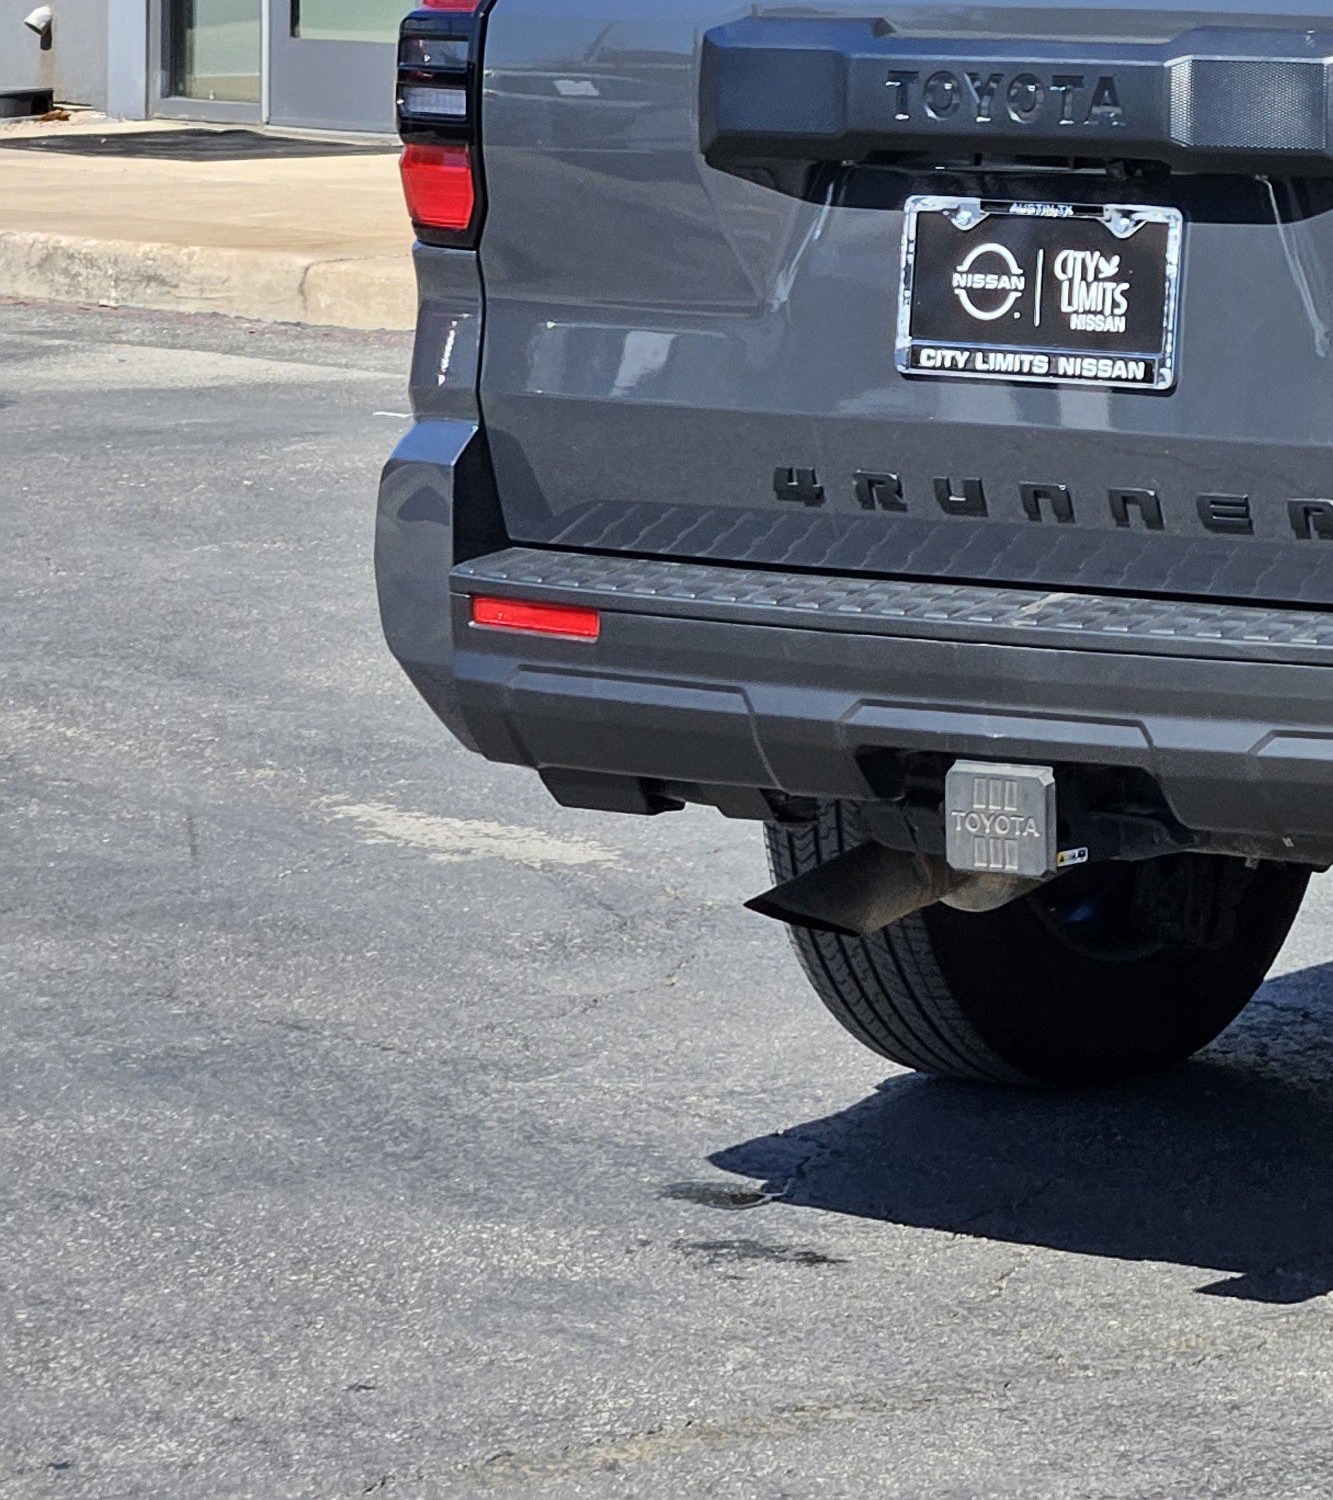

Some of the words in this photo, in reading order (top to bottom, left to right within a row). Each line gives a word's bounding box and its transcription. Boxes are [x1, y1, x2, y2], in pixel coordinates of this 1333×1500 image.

[884, 69, 1127, 127] TOYOTA
[952, 272, 1025, 291] NISSAN
[1054, 249, 1101, 282] CITY
[1060, 280, 1130, 316] LIMITS
[1070, 313, 1126, 334] NISSAN
[919, 348, 970, 369] CITY
[974, 351, 1049, 375] LIMITS
[1057, 356, 1146, 381] NISSAN
[951, 810, 1041, 838] TOYOTA
